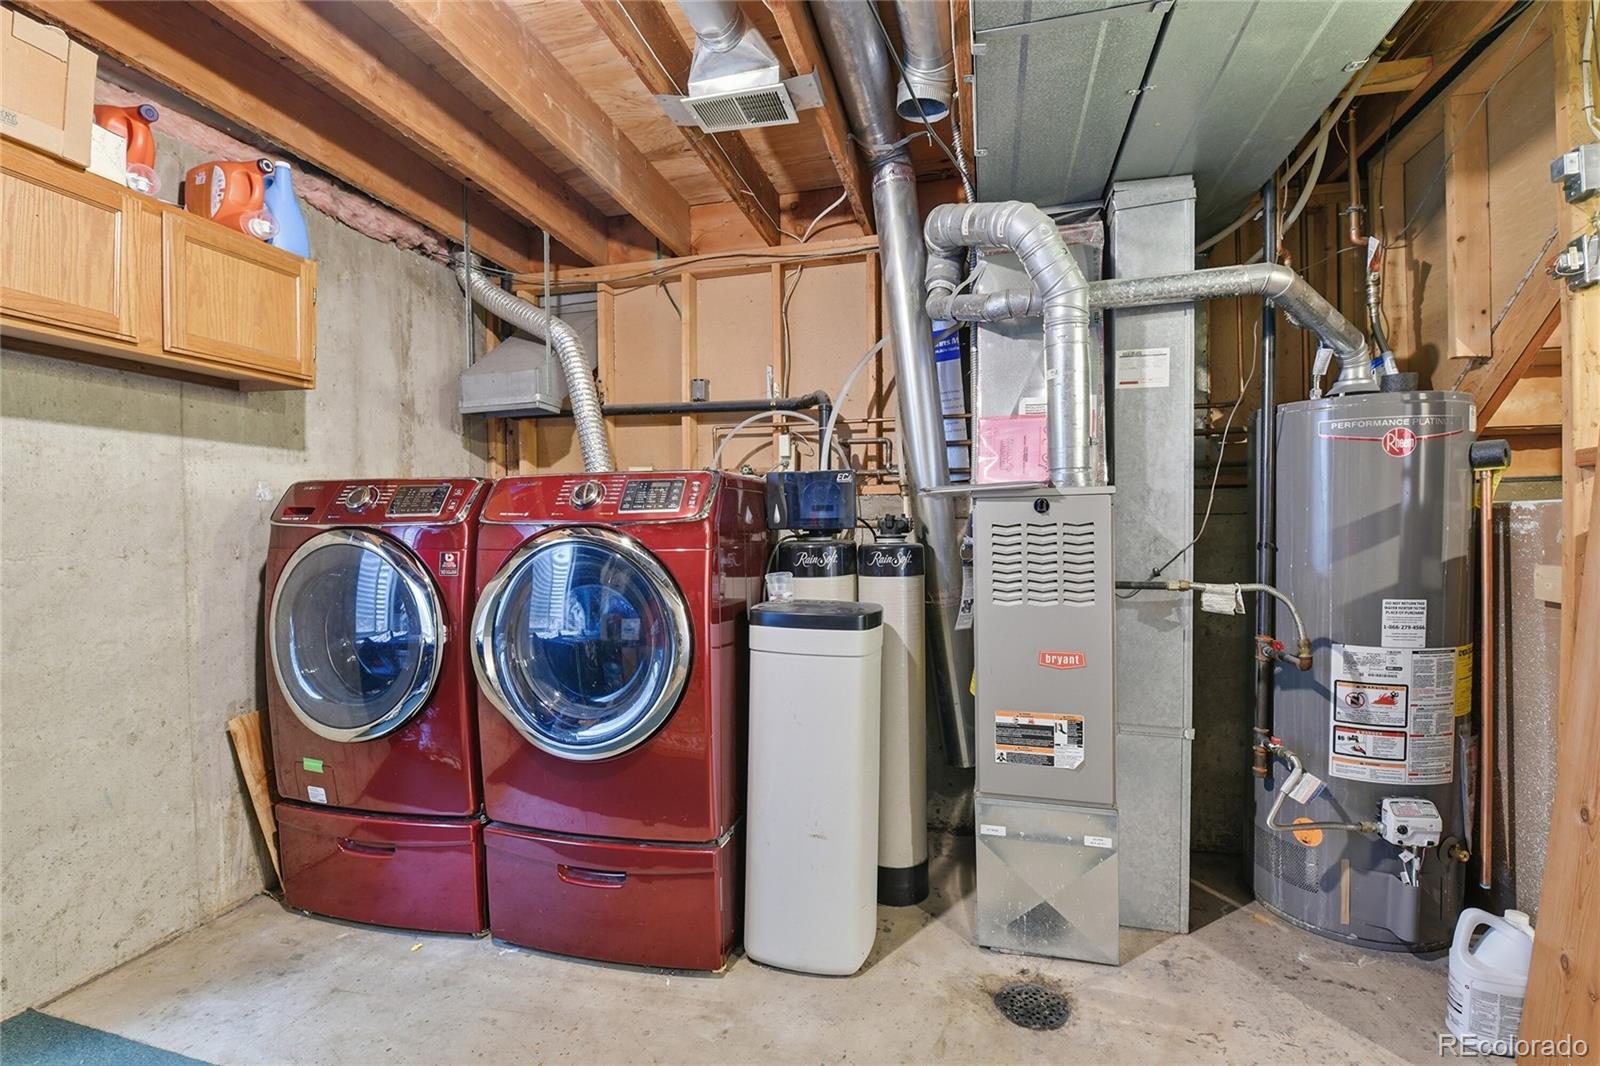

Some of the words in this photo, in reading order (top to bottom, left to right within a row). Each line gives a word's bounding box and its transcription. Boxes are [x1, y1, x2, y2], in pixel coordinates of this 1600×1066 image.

[1331, 418, 1410, 430] PERFORMANCE
[1412, 416, 1456, 426] PLATIN
[1386, 429, 1415, 453] Rheem
[793, 549, 838, 570] RainSoft
[867, 549, 912, 570] RainSoft
[1045, 653, 1080, 666] bryant
